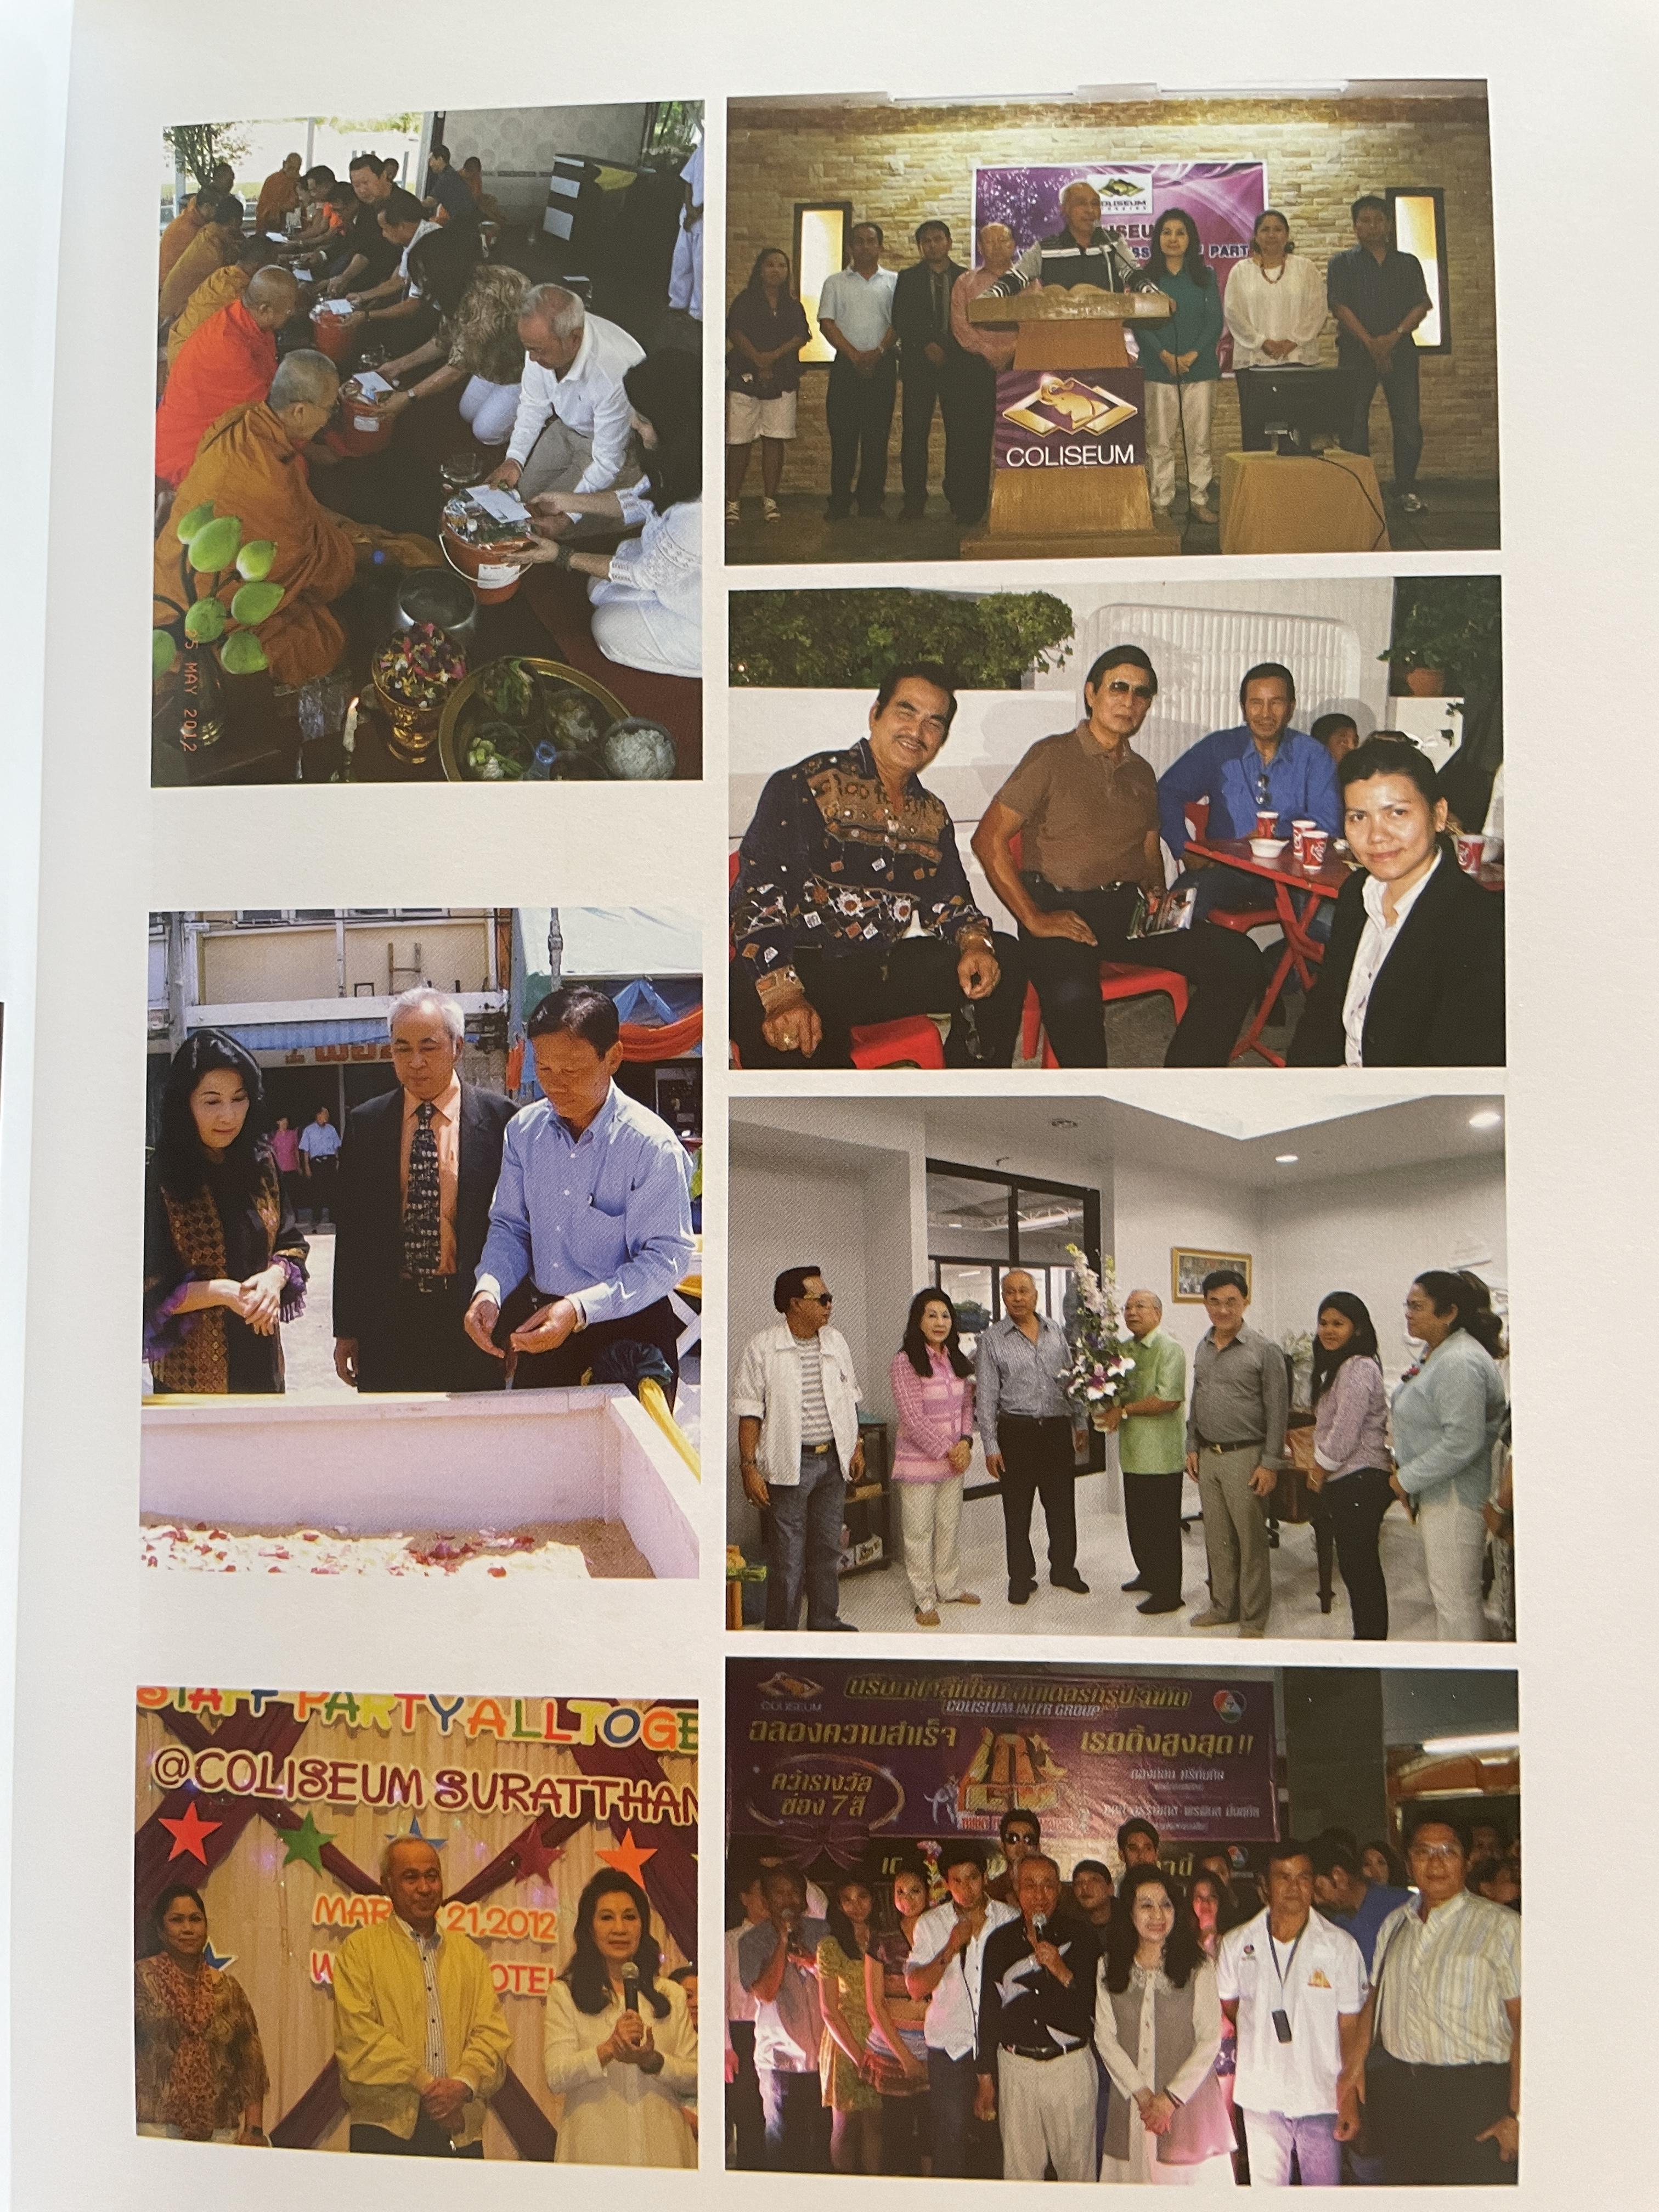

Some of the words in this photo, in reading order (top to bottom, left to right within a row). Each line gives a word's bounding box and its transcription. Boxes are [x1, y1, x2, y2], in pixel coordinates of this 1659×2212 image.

[1006, 444, 1134, 467] COLISEUM
[154, 1748, 422, 1807] @COLISEUM
[314, 1895, 393, 1925] MAR
[447, 1904, 557, 1940] 21,2012
[490, 1963, 554, 1994] OTE
